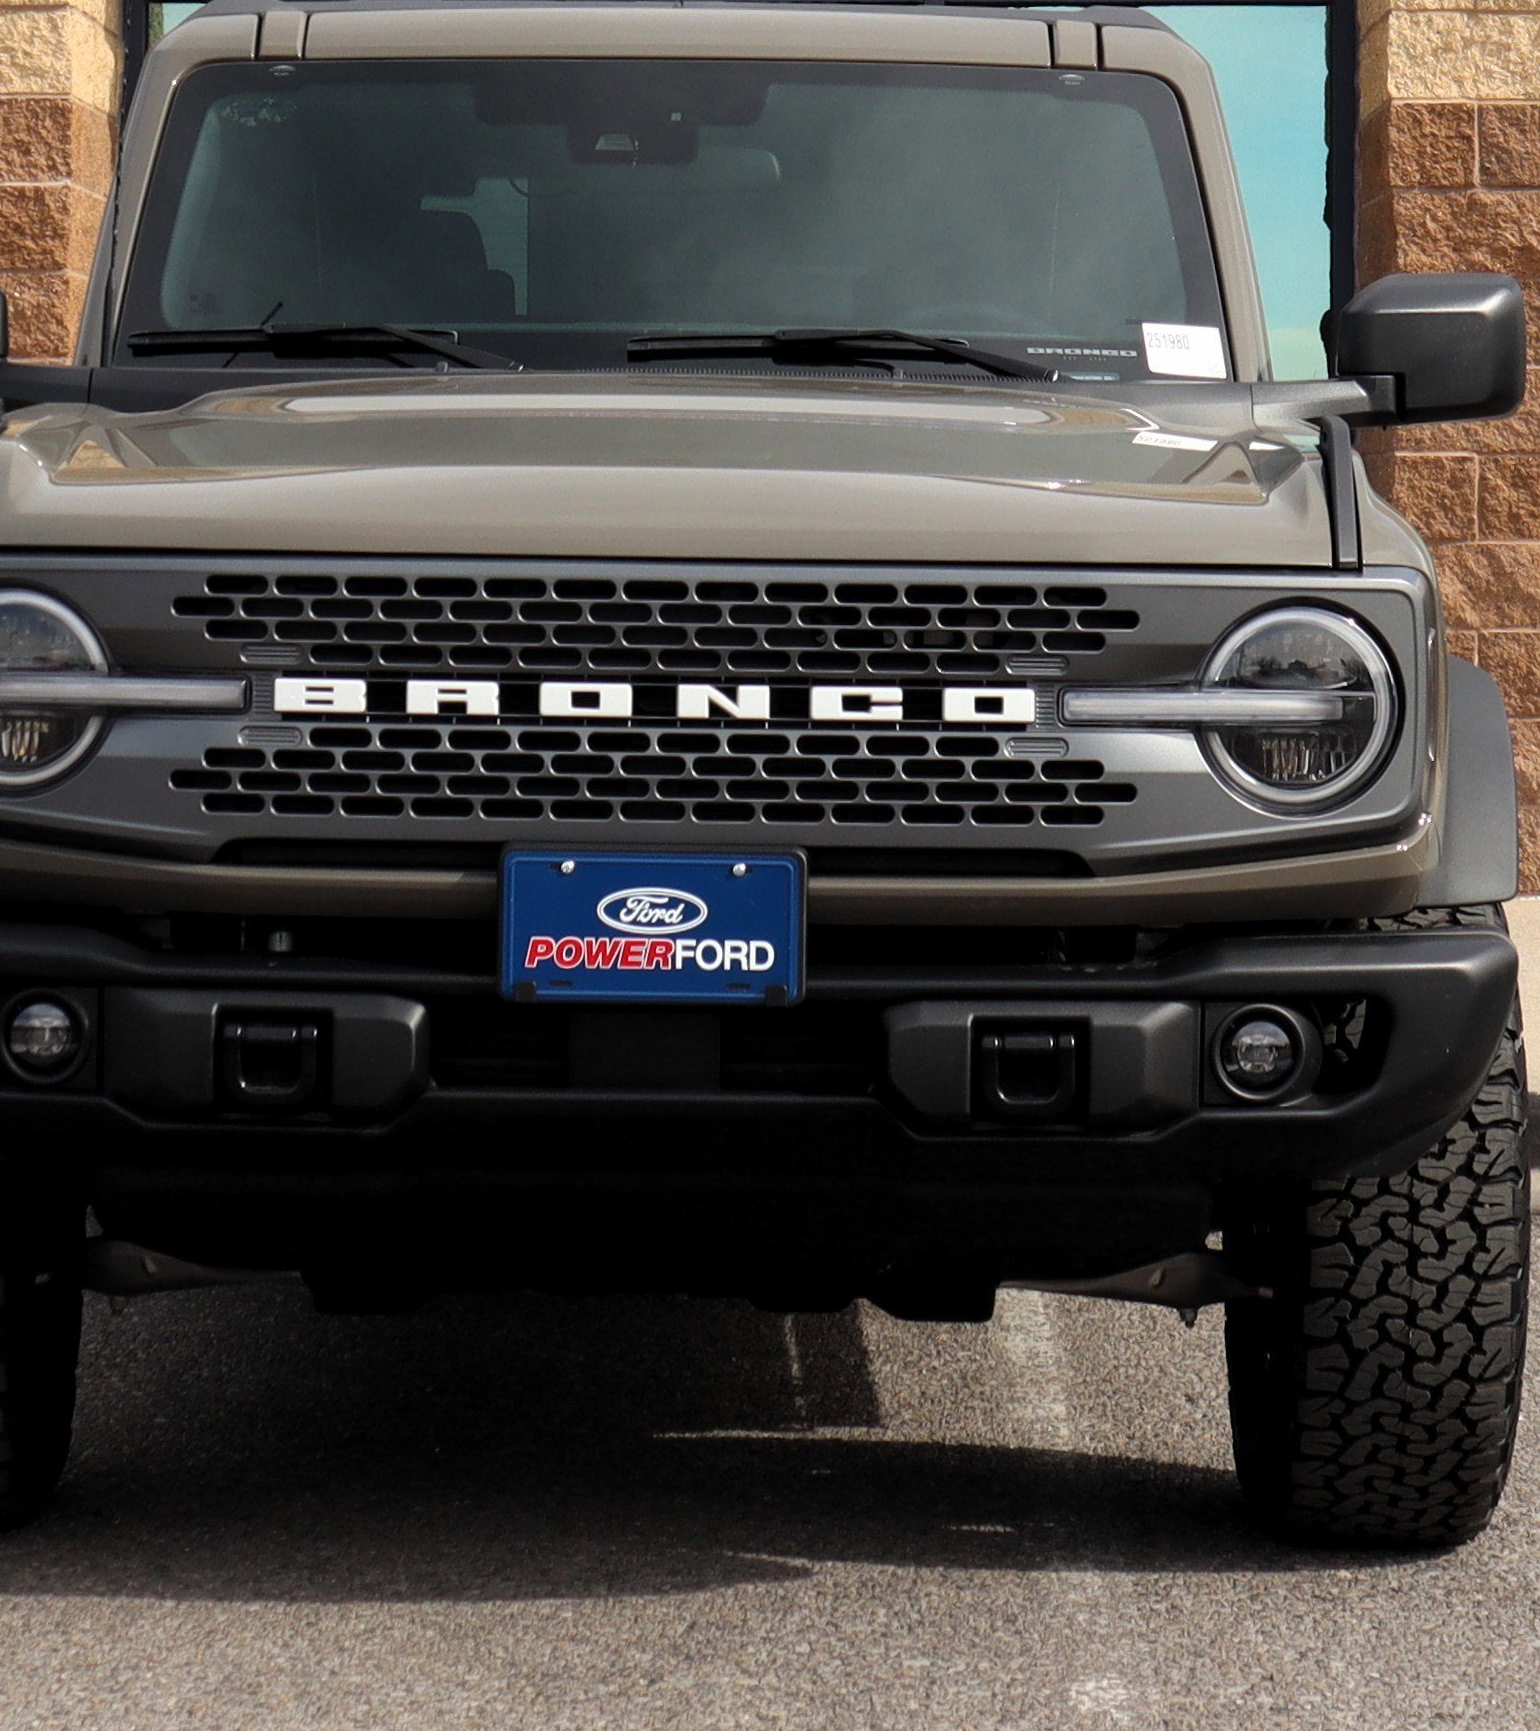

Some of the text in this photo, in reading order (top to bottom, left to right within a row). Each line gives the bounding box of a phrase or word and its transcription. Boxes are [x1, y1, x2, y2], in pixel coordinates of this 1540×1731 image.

[1027, 347, 1138, 357] BRONCO
[1147, 332, 1190, 350] 251980
[273, 677, 1037, 725] BRONCO
[619, 895, 685, 924] Ford
